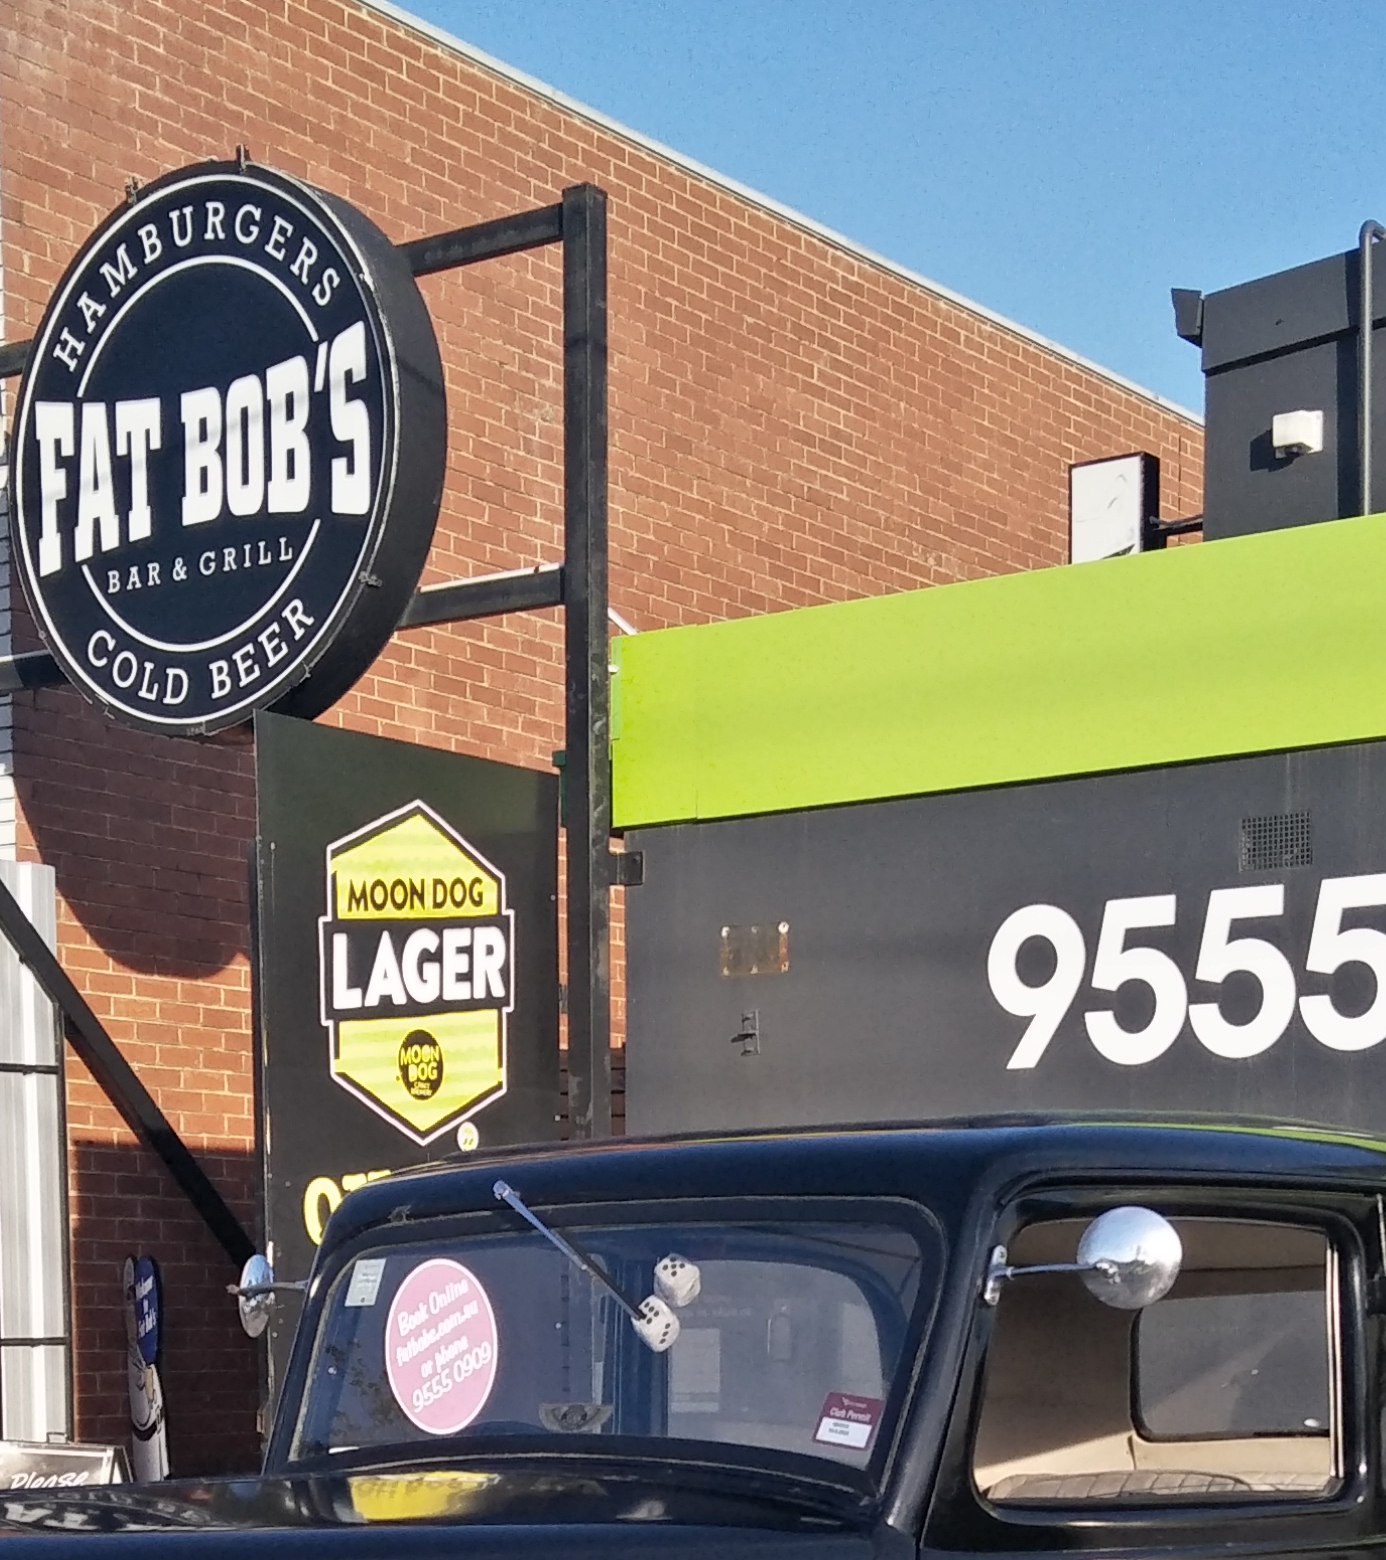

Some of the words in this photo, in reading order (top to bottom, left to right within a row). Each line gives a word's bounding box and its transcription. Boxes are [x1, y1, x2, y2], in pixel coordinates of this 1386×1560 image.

[54, 202, 340, 372] HAMBURGERS
[35, 399, 162, 577] FAT
[182, 321, 371, 526] BOB'S
[107, 563, 162, 594] BAR
[172, 558, 188, 581] &
[199, 537, 294, 576] GRILL
[88, 629, 190, 705] COLD
[211, 598, 316, 699] BEER
[348, 877, 426, 912] MOON
[432, 877, 484, 910] DOG
[332, 926, 507, 1010] LAGER
[400, 1044, 440, 1066] MOON
[408, 1061, 438, 1082] DOG
[397, 1302, 429, 1336] Book
[429, 1278, 469, 1315] Online
[413, 1369, 453, 1413] 9555
[453, 1341, 492, 1383] 0909
[421, 1359, 433, 1378] or
[435, 1335, 469, 1373] phone
